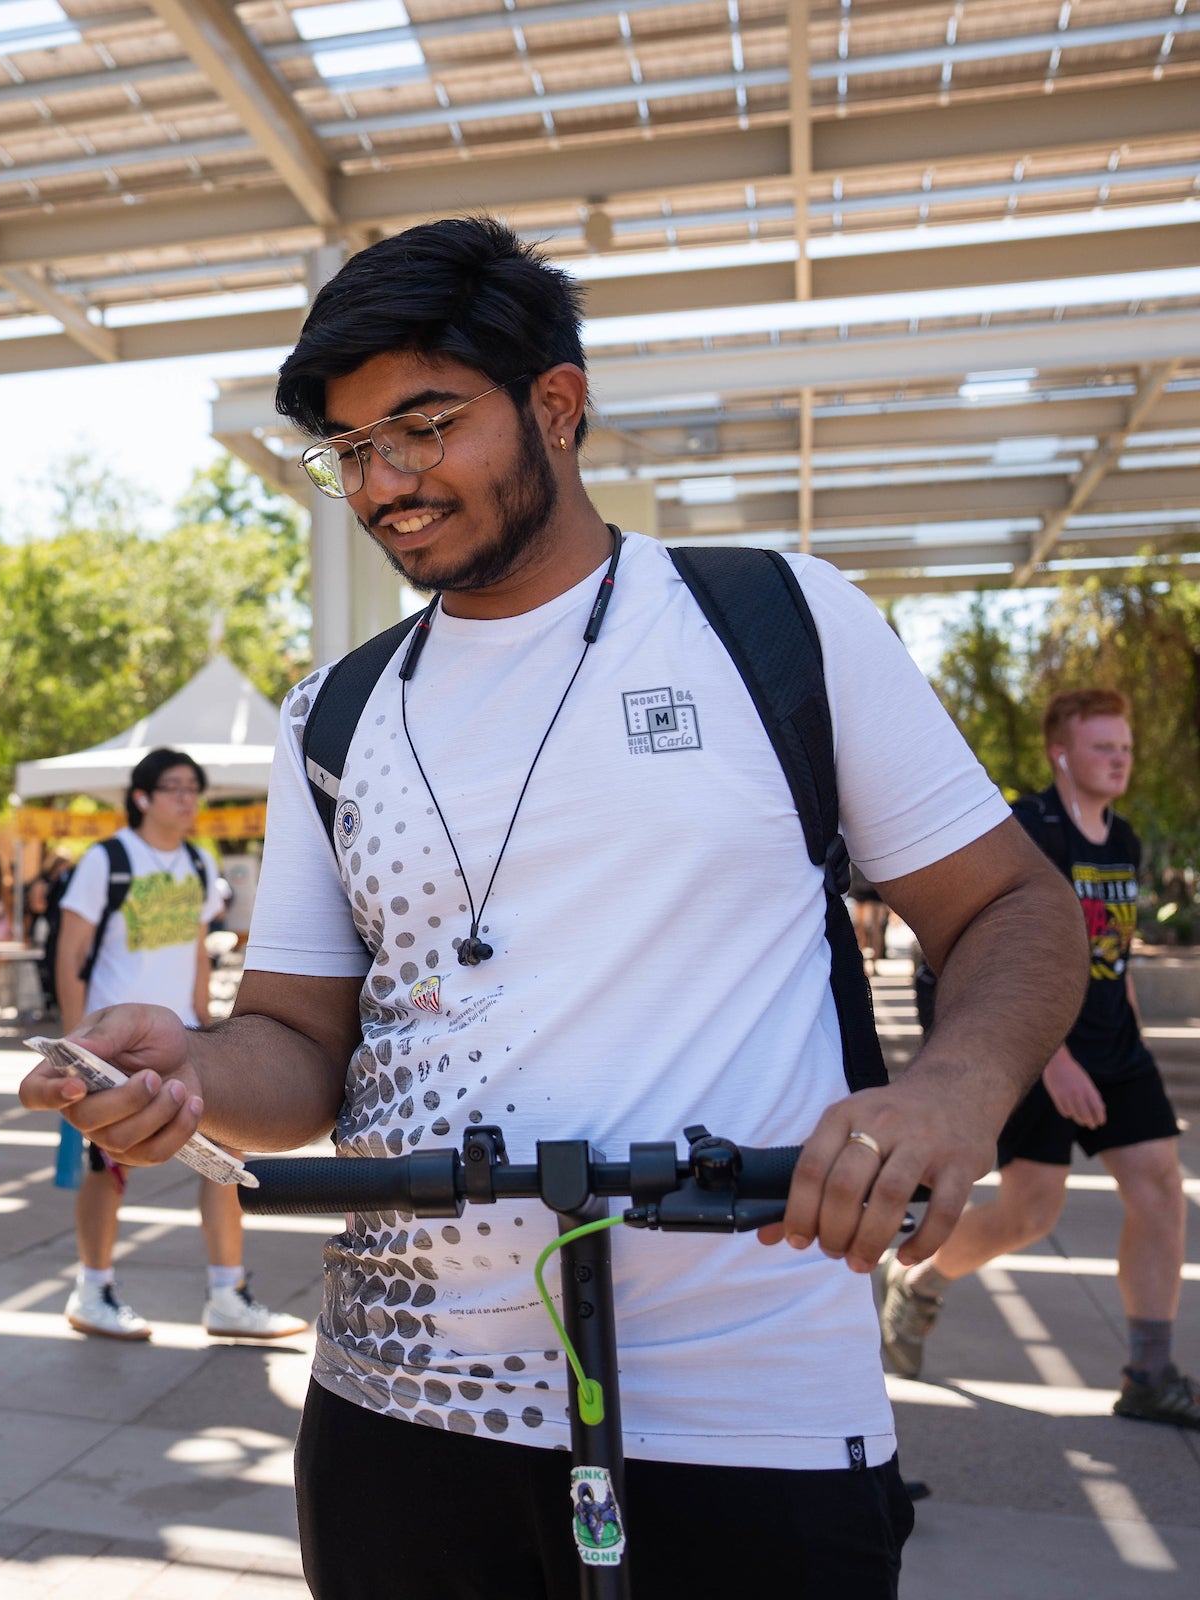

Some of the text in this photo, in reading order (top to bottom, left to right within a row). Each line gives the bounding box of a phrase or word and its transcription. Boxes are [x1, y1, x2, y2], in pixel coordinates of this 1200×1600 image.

[630, 694, 667, 706] MONTE
[676, 690, 694, 701] 84
[655, 712, 669, 726] M
[627, 737, 649, 746] NINE
[657, 732, 693, 748] Carlo
[628, 745, 650, 755] TEEN
